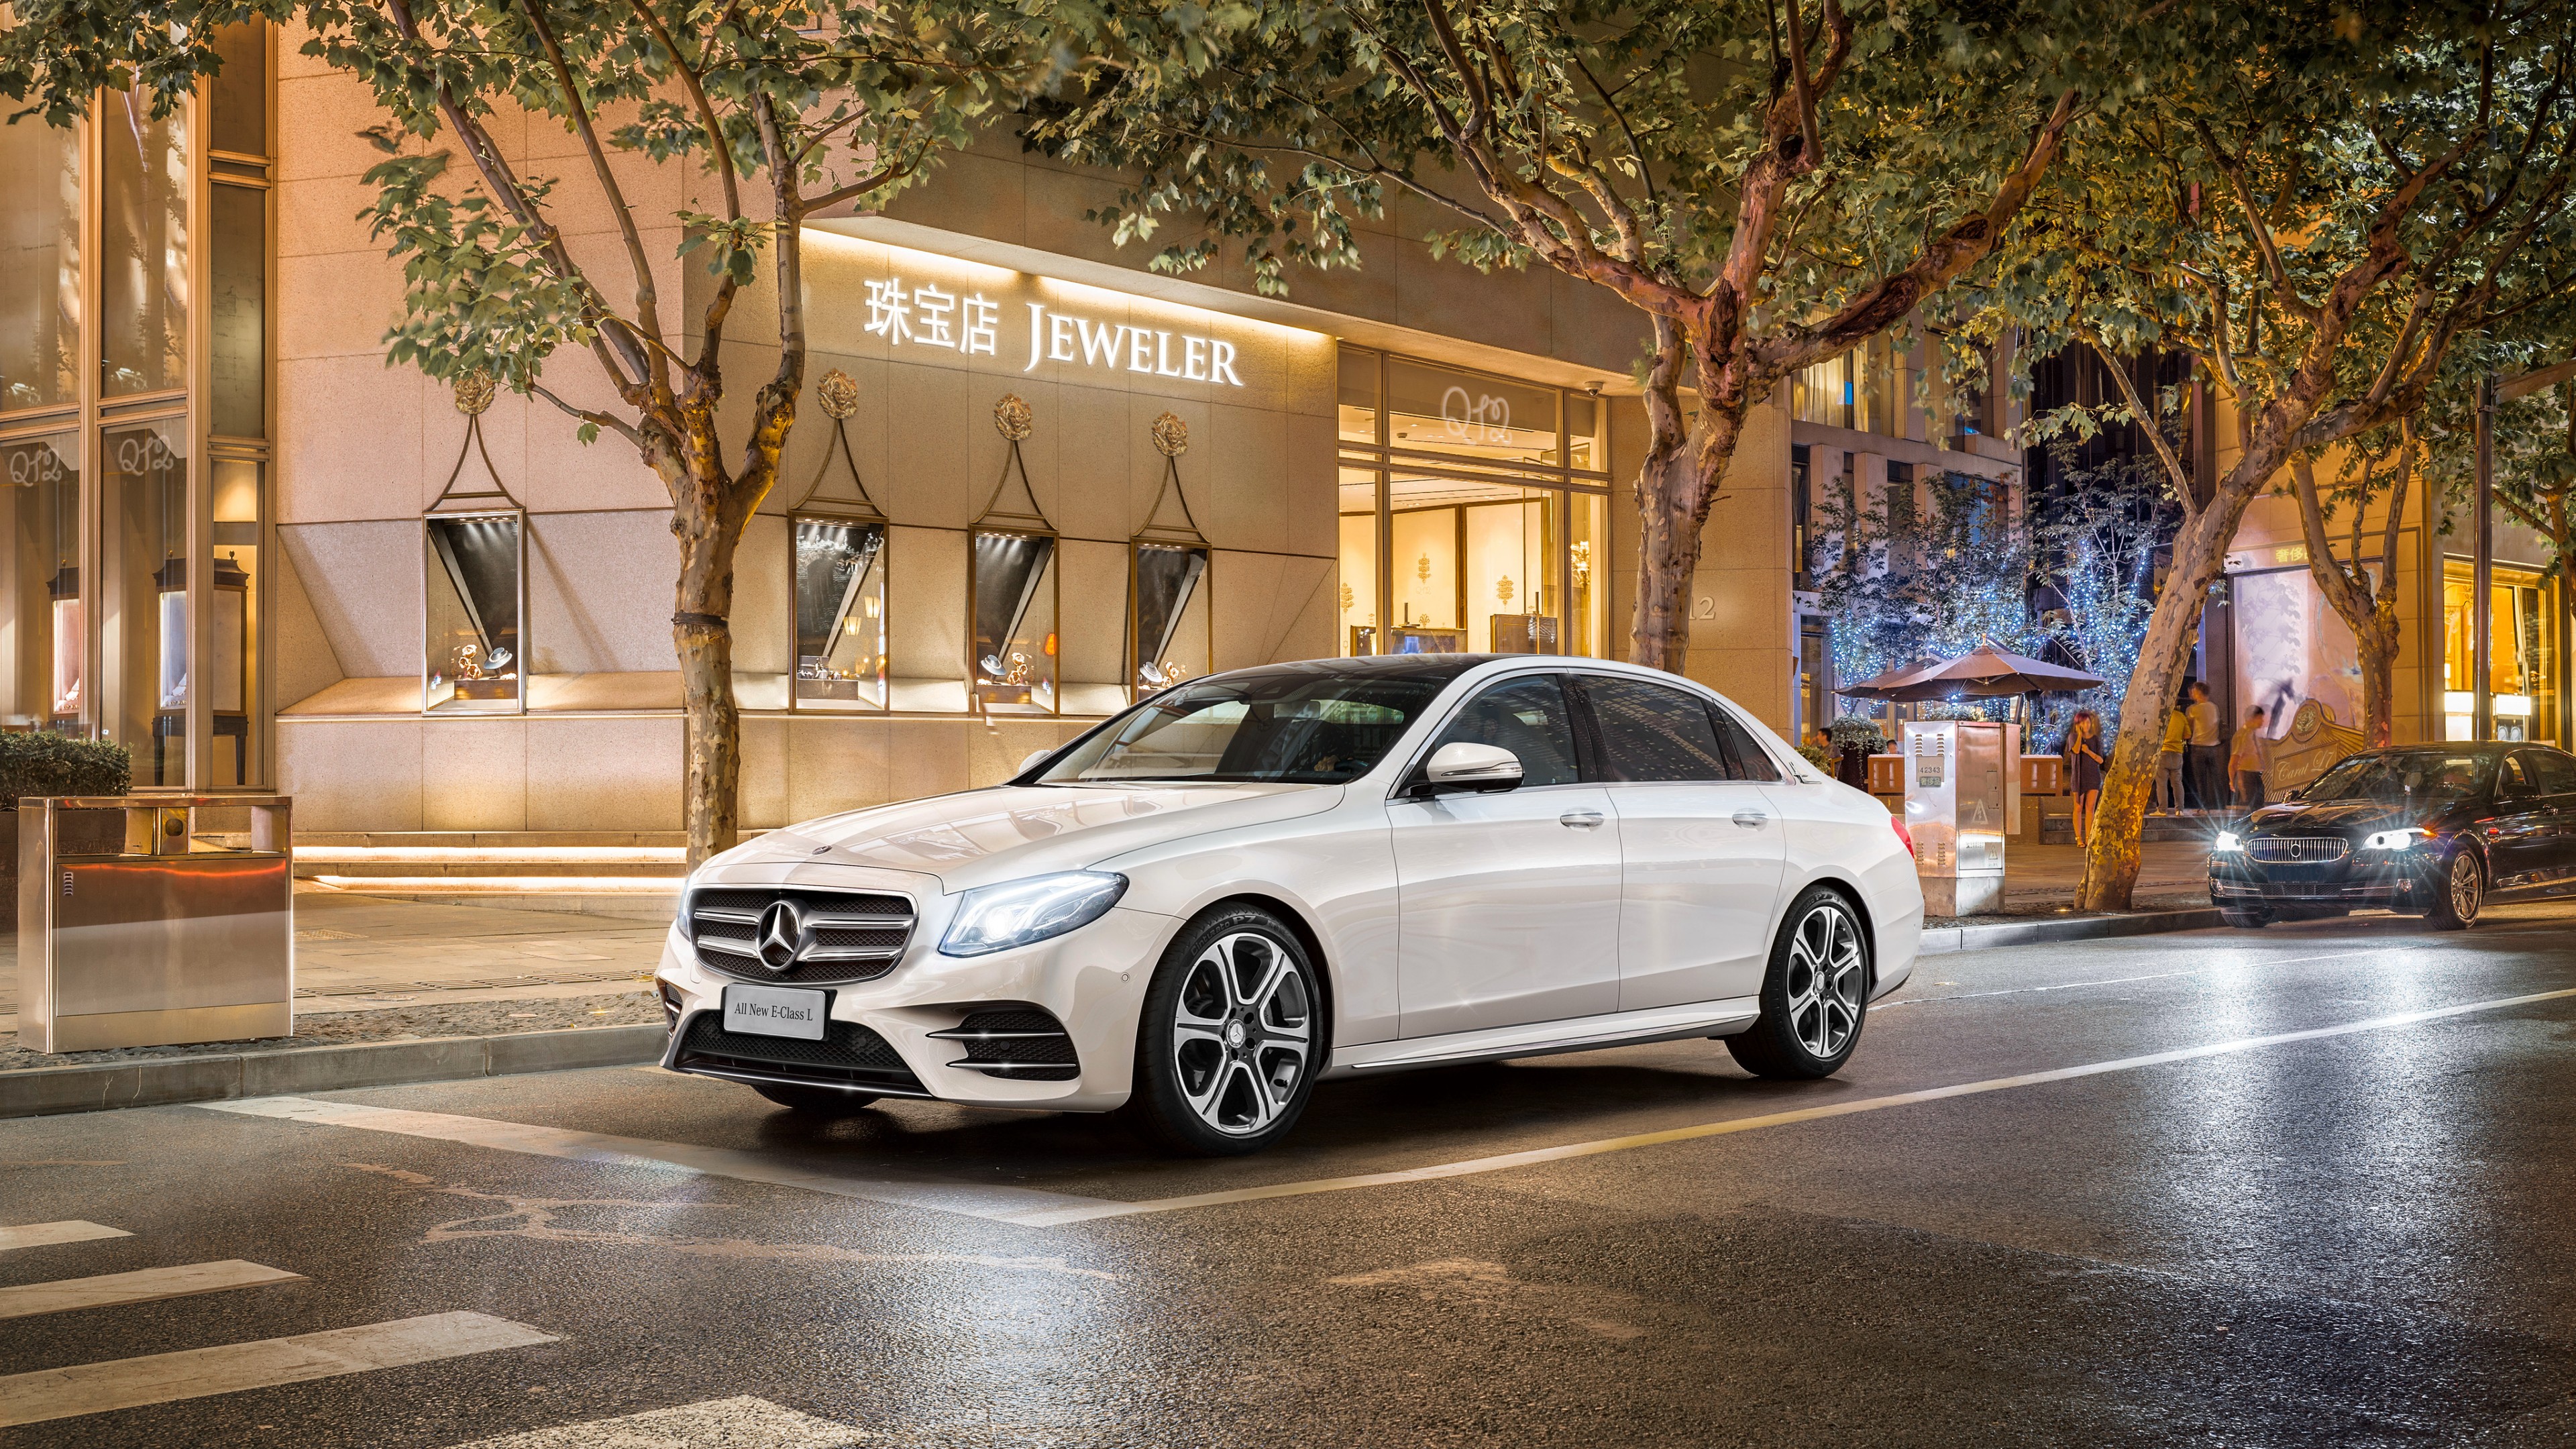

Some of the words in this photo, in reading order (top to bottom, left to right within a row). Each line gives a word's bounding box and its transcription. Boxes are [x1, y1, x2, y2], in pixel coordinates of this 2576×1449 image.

[863, 276, 998, 356] 珠宝店
[1024, 303, 1243, 386] JEWELER
[2276, 761, 2309, 782] Carat
[1232, 915, 1256, 924] P7
[734, 1002, 747, 1014] All
[749, 1003, 769, 1017] New
[771, 1005, 804, 1020] E-Class
[807, 1008, 813, 1021] L
